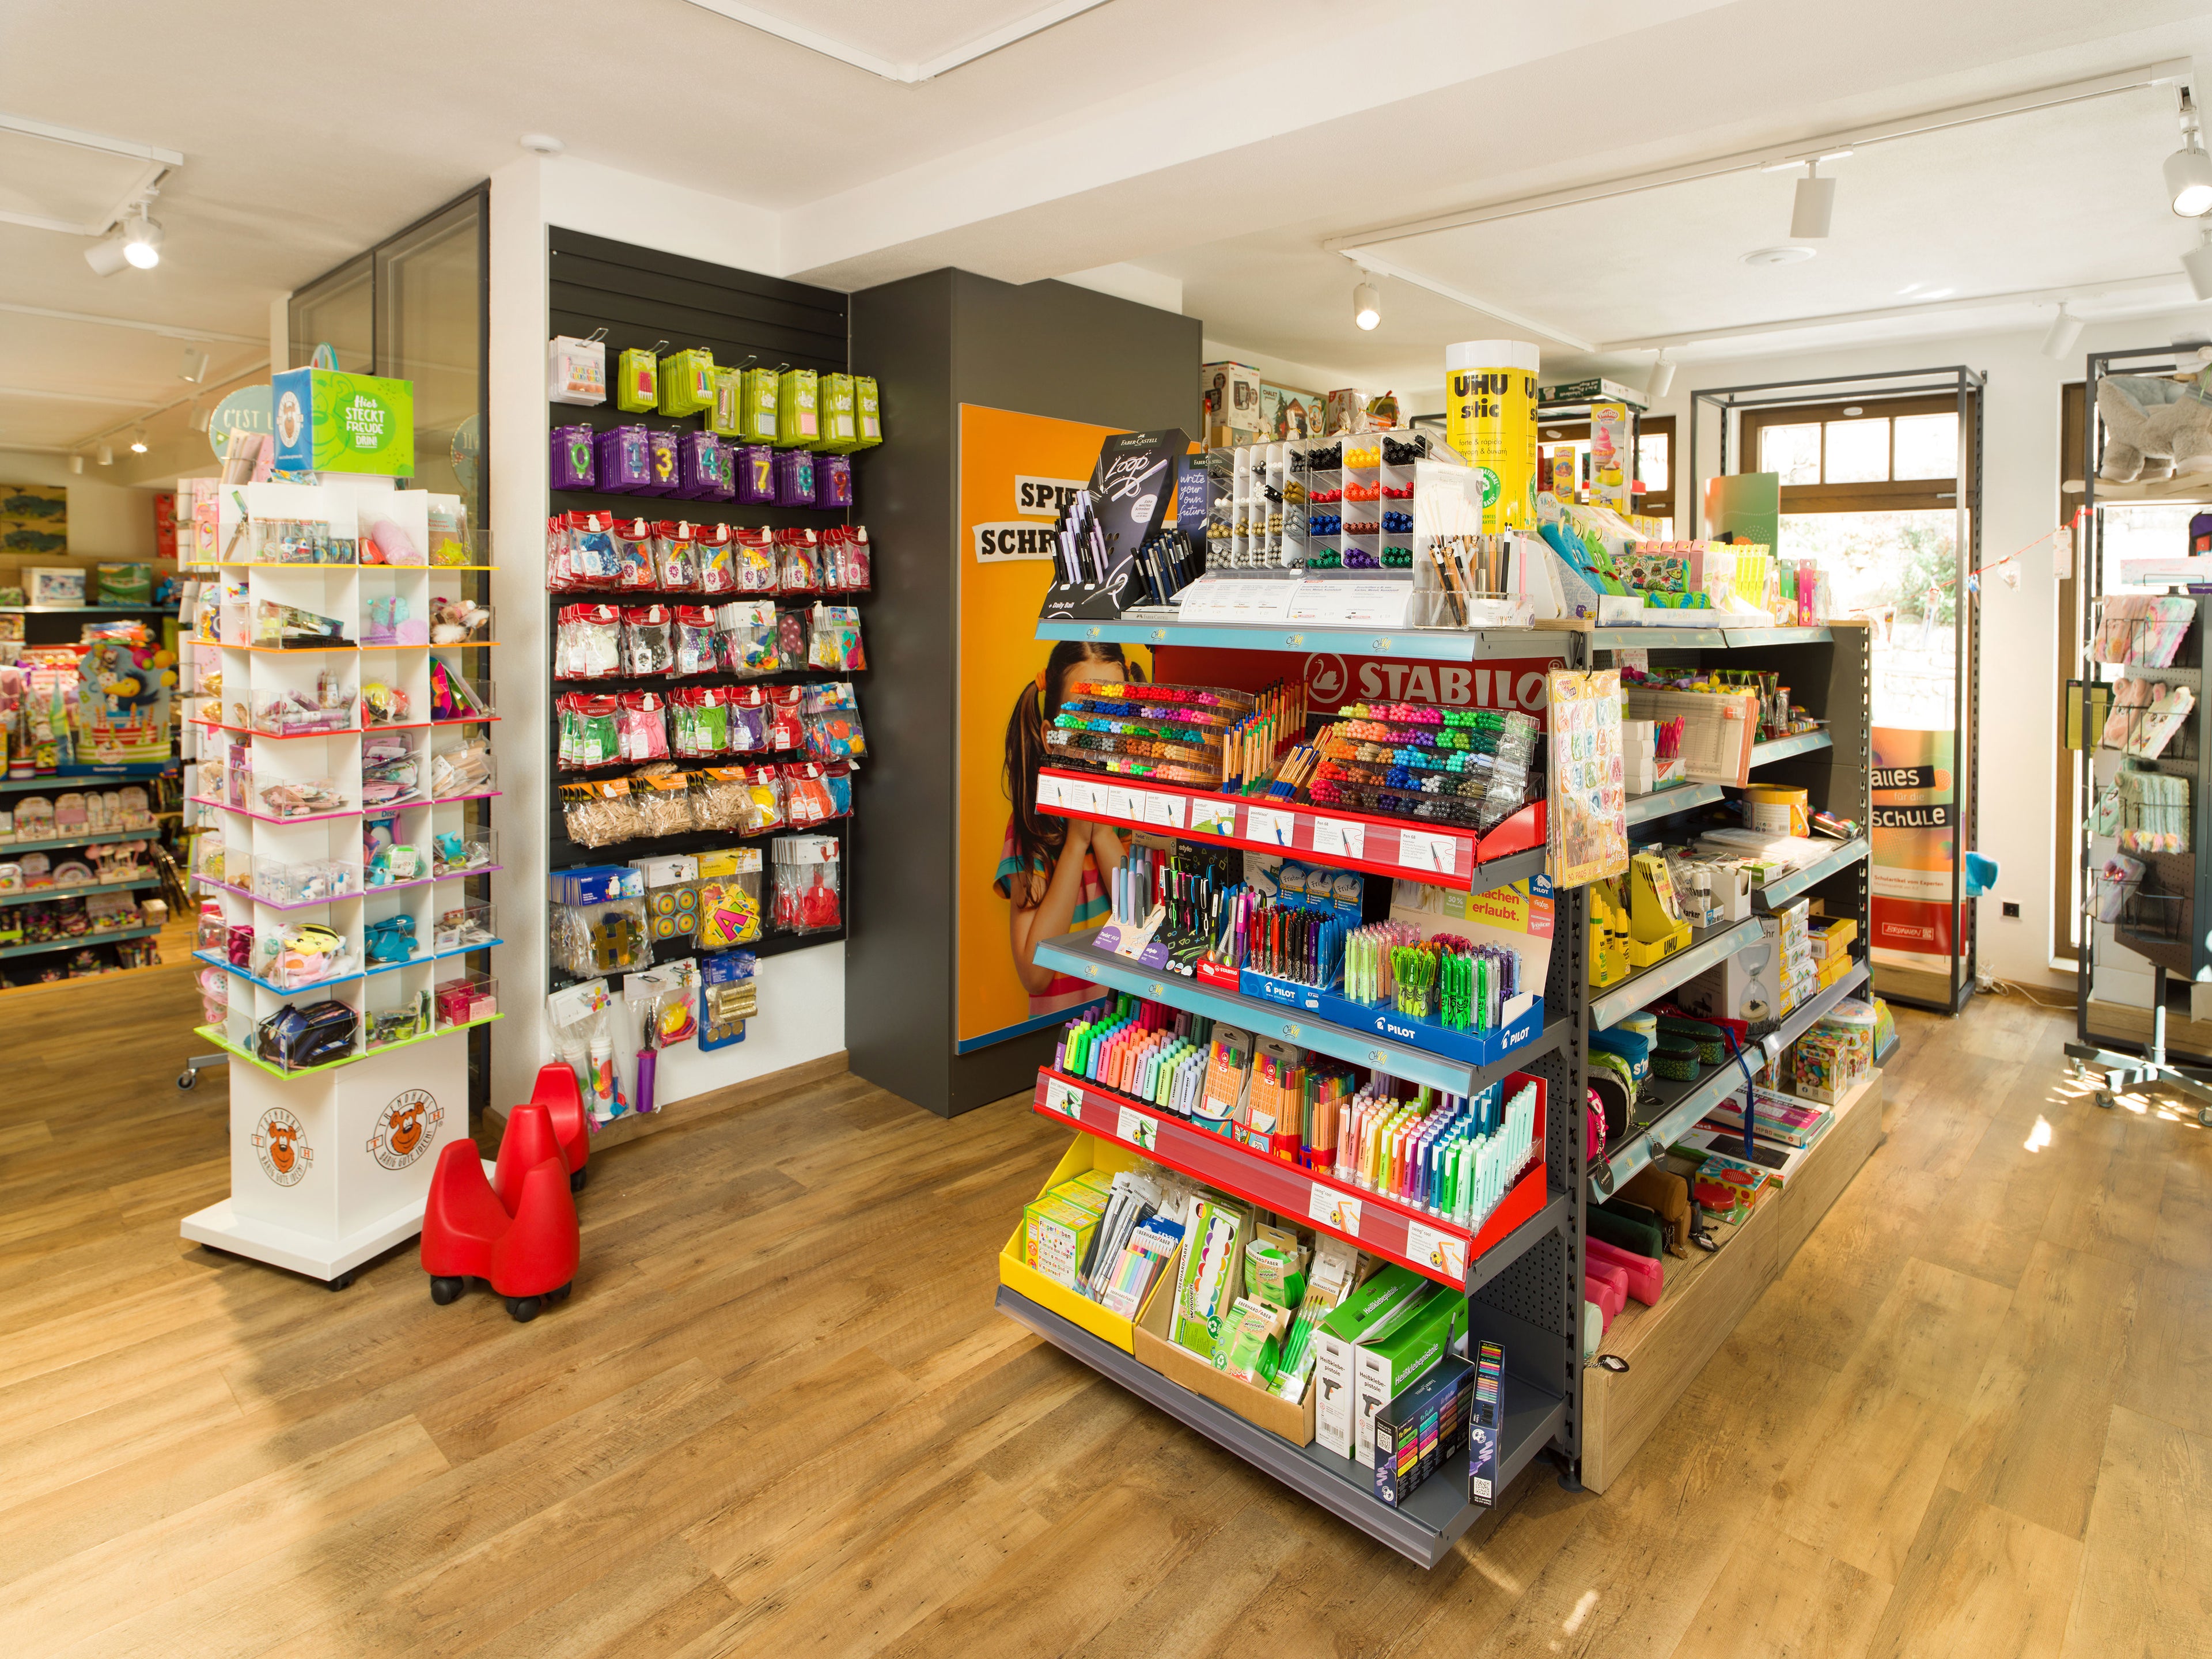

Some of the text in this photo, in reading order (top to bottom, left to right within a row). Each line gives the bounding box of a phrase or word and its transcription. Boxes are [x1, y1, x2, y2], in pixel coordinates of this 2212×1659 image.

[1455, 374, 1508, 397] UHU
[355, 395, 378, 408] Hier
[1461, 398, 1499, 419] stic
[224, 408, 260, 429] C'EST
[346, 407, 385, 423] STECKT
[346, 421, 384, 434] FREUDE
[355, 435, 378, 446] DRIN!
[1481, 438, 1502, 448] rápido
[1105, 454, 1150, 482] Loop
[1180, 474, 1206, 484] write
[1021, 482, 1086, 510] SPIE
[1179, 486, 1203, 501] your
[1184, 496, 1203, 505] own
[1177, 505, 1207, 523] future
[982, 528, 1055, 555] SCHR
[1359, 662, 1547, 711] STABILO
[1871, 769, 1920, 786] alles
[1894, 791, 1925, 801] für die
[1179, 844, 1192, 853] style
[1568, 873, 1574, 882] 30
[1575, 869, 1587, 880] PADS
[1533, 887, 1549, 895] PILOT
[1472, 903, 1520, 922] erlaubt.
[1664, 936, 1677, 955] UHU
[1219, 967, 1238, 975] STABILO
[1274, 987, 1296, 999] PILOT
[1388, 1024, 1415, 1039] PILOT
[1510, 1027, 1530, 1046] PILOT
[1363, 1285, 1399, 1315] Heißklebepistole
[1244, 1321, 1265, 1330] WINNER
[1320, 1355, 1346, 1372] Heißklebe-
[1324, 1365, 1341, 1377] pistole
[1395, 1342, 1439, 1387] Heißklebepistole
[1359, 1371, 1387, 1387] Heißklebe-
[1364, 1381, 1381, 1393] pistole
